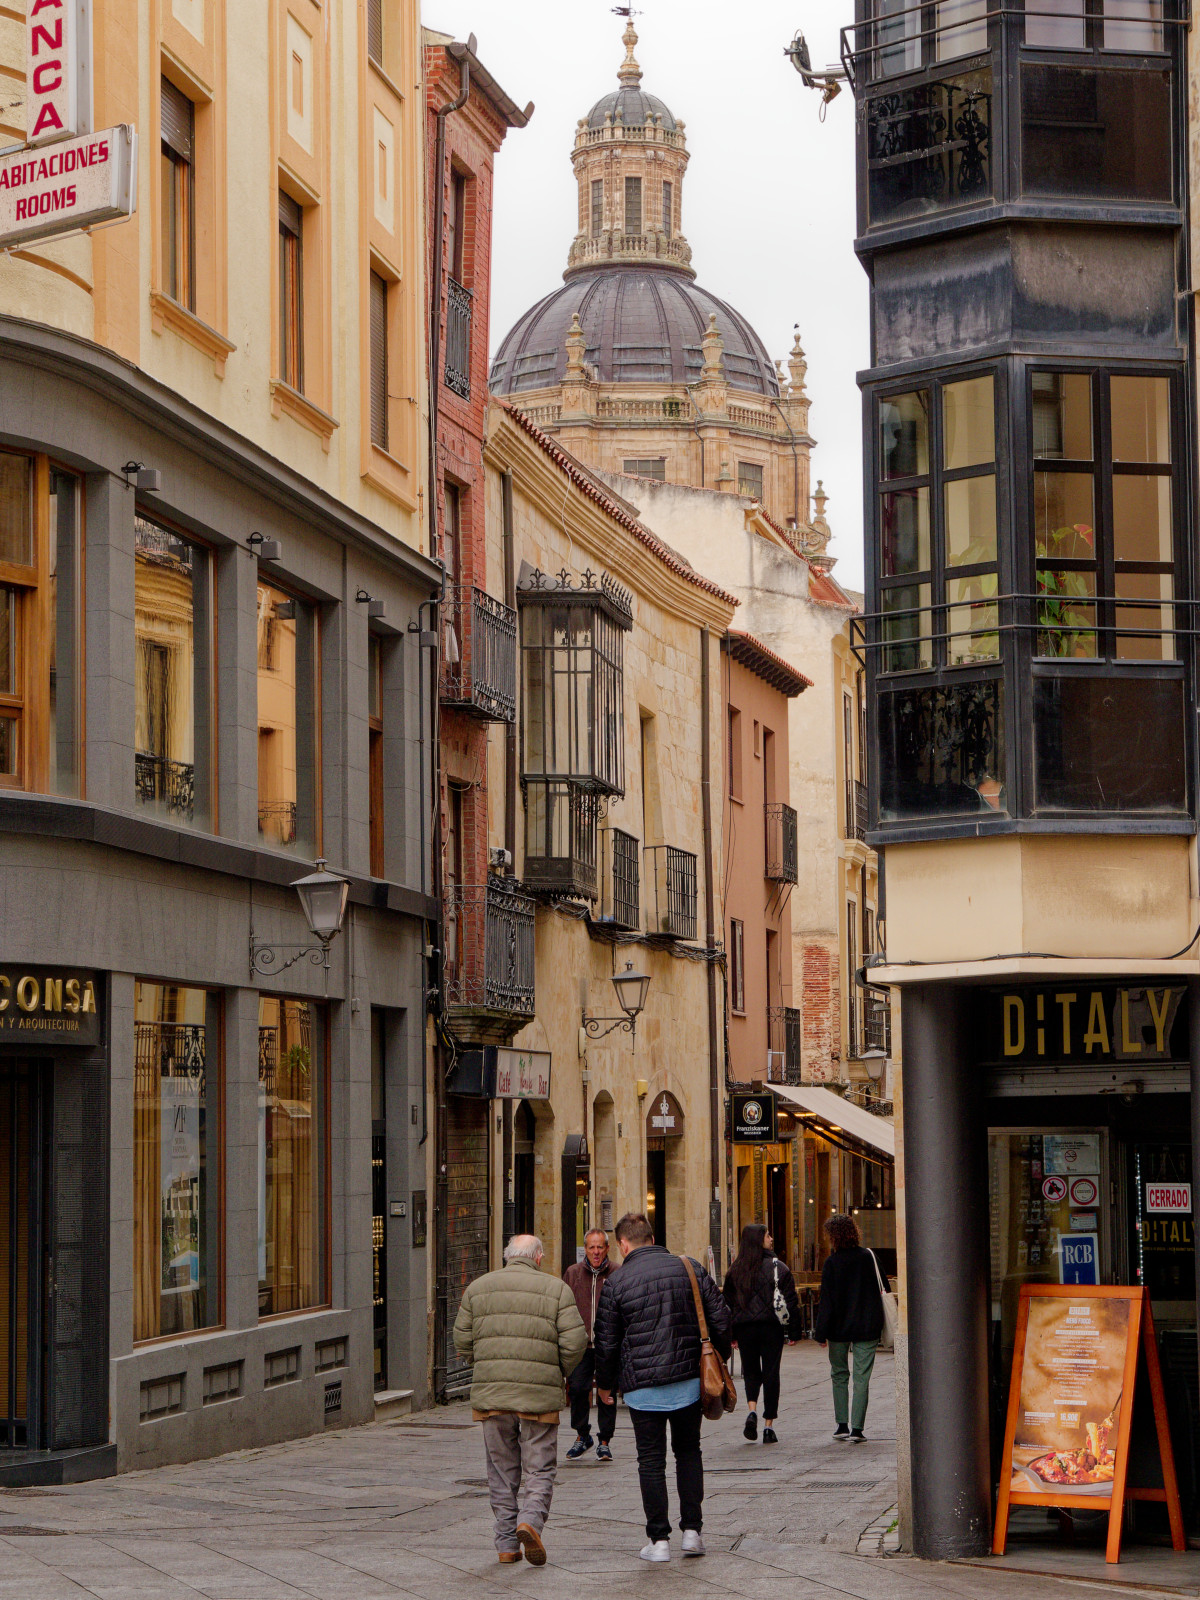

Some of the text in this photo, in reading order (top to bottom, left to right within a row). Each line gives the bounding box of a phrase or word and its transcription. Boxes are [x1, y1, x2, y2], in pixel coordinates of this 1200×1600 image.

[15, 184, 77, 221] ROOMS
[8, 1018, 15, 1029] Y
[19, 1018, 80, 1032] ARQUITECTURA
[498, 1071, 511, 1093] Café
[538, 1074, 547, 1095] Bar
[1149, 1189, 1188, 1208] CERRADO
[1064, 1244, 1093, 1264] RCB
